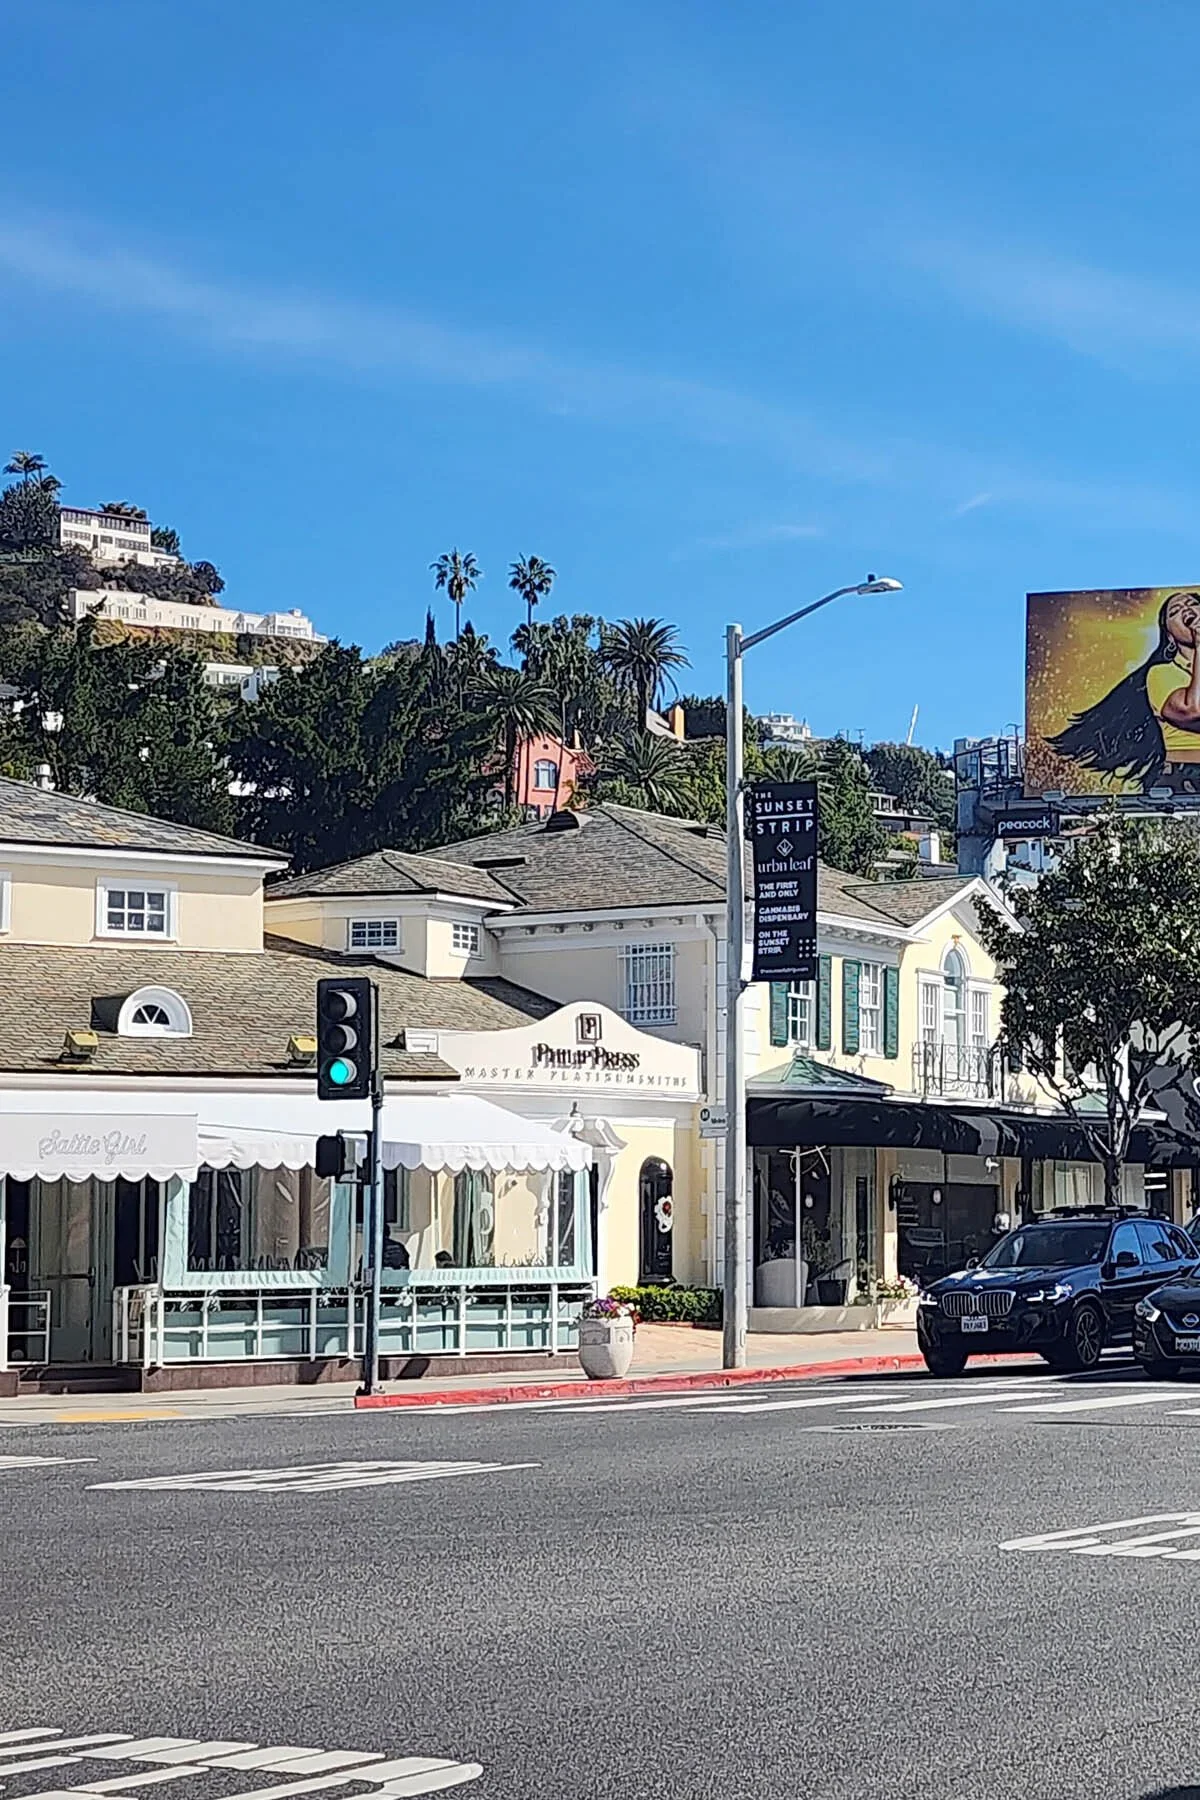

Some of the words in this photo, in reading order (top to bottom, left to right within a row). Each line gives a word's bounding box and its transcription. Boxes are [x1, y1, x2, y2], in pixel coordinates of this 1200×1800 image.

[755, 791, 772, 799] THE
[755, 799, 814, 813] SUNSET
[756, 820, 814, 835] STRIP
[998, 816, 1051, 835] peacock
[789, 856, 814, 871] leaf
[759, 882, 775, 891] THE
[776, 881, 798, 889] FIRST
[759, 891, 777, 899] AND
[778, 889, 799, 898] ONLY
[759, 905, 801, 914] CANNABIS
[759, 912, 809, 923] DISPENSARY
[758, 931, 771, 939] ON
[772, 930, 788, 938] THE
[758, 938, 790, 947] SUNSET
[464, 1067, 536, 1080] MASTER
[102, 1130, 147, 1165] Girl
